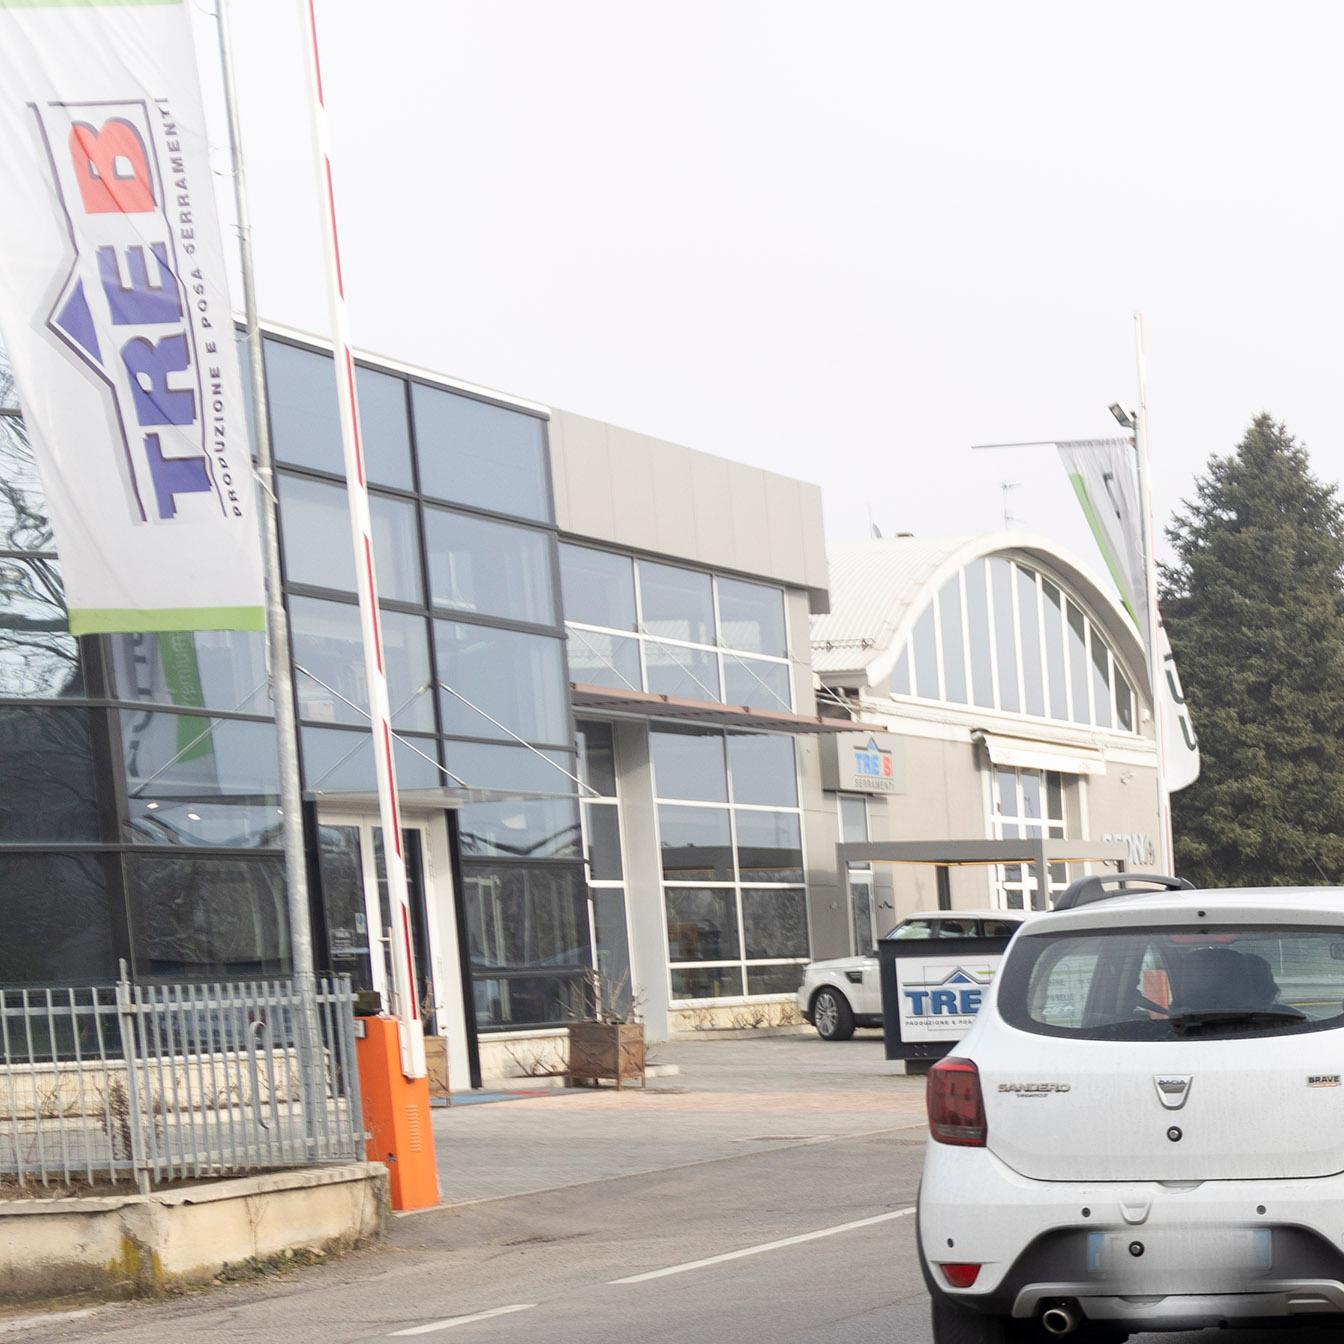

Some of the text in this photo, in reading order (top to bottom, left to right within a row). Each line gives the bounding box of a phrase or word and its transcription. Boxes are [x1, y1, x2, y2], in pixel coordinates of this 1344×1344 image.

[68, 117, 214, 521] TRE B
[154, 97, 244, 519] PRODUZIONE E POSA SERRAMENTI
[854, 752, 880, 776] TRE
[903, 989, 982, 1016] TRE
[998, 1082, 1072, 1093] SANDERO
[1308, 1075, 1341, 1084] BRAVE
